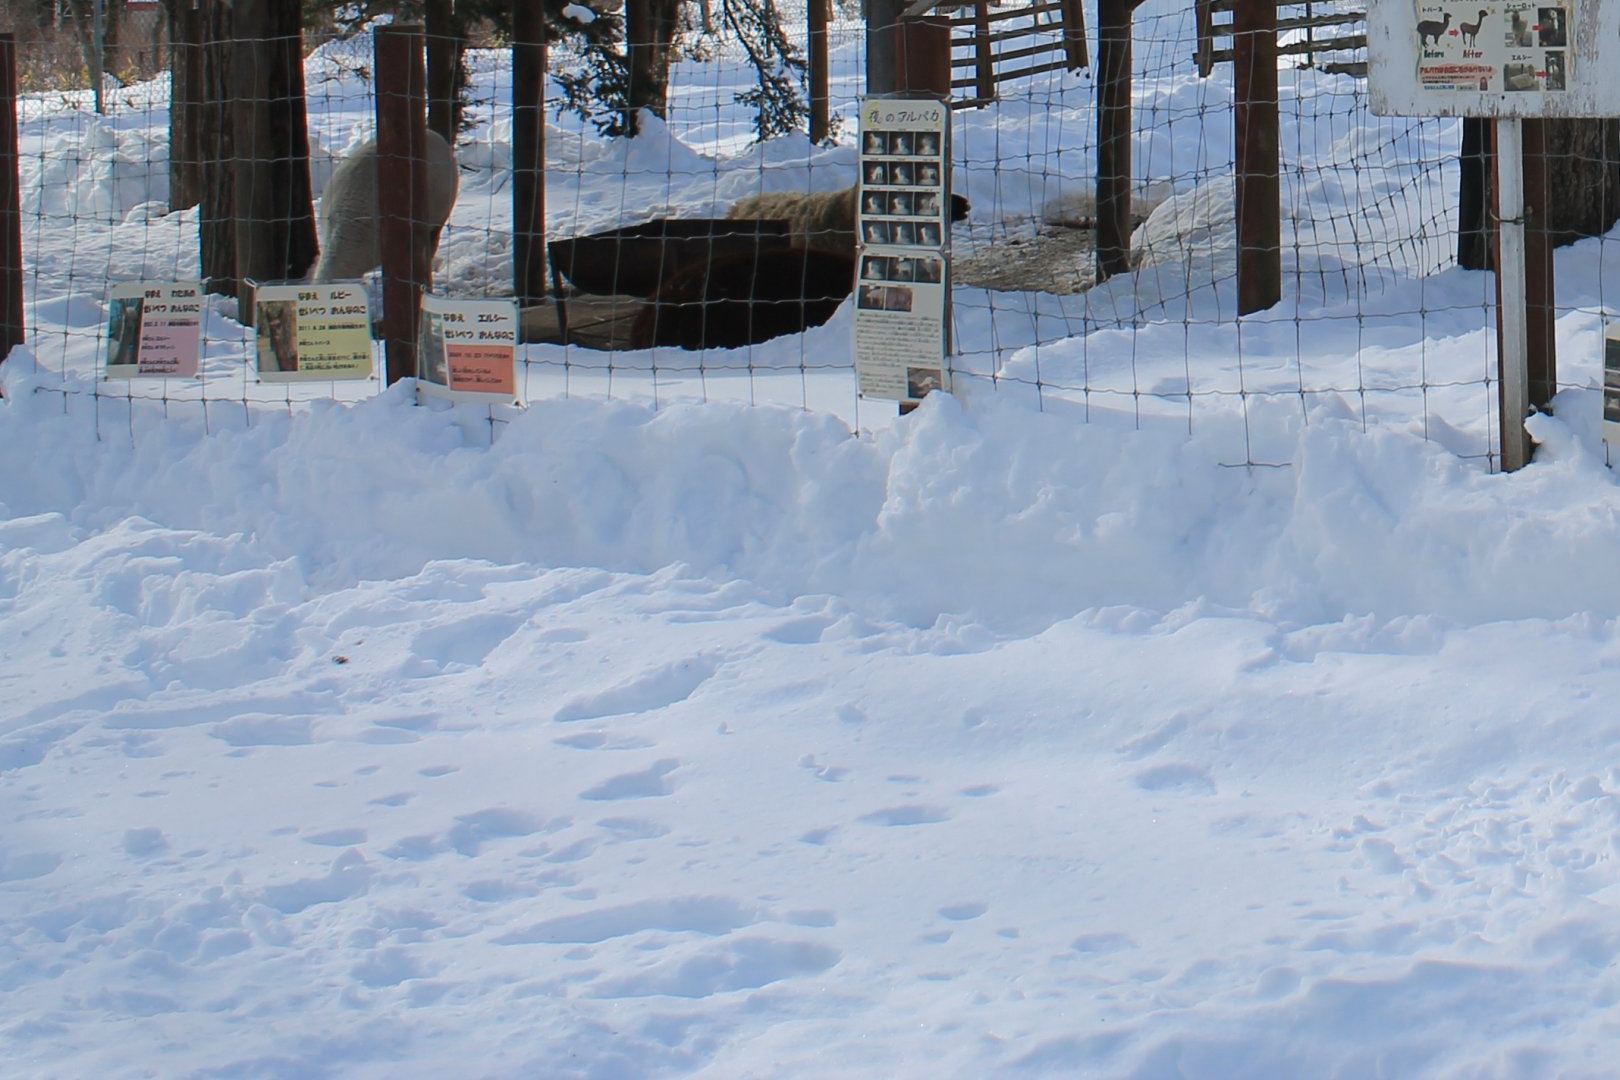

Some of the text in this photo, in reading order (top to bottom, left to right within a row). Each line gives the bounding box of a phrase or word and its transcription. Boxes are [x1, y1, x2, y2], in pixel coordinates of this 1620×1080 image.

[1462, 49, 1484, 59] After
[477, 313, 509, 323] エルシー
